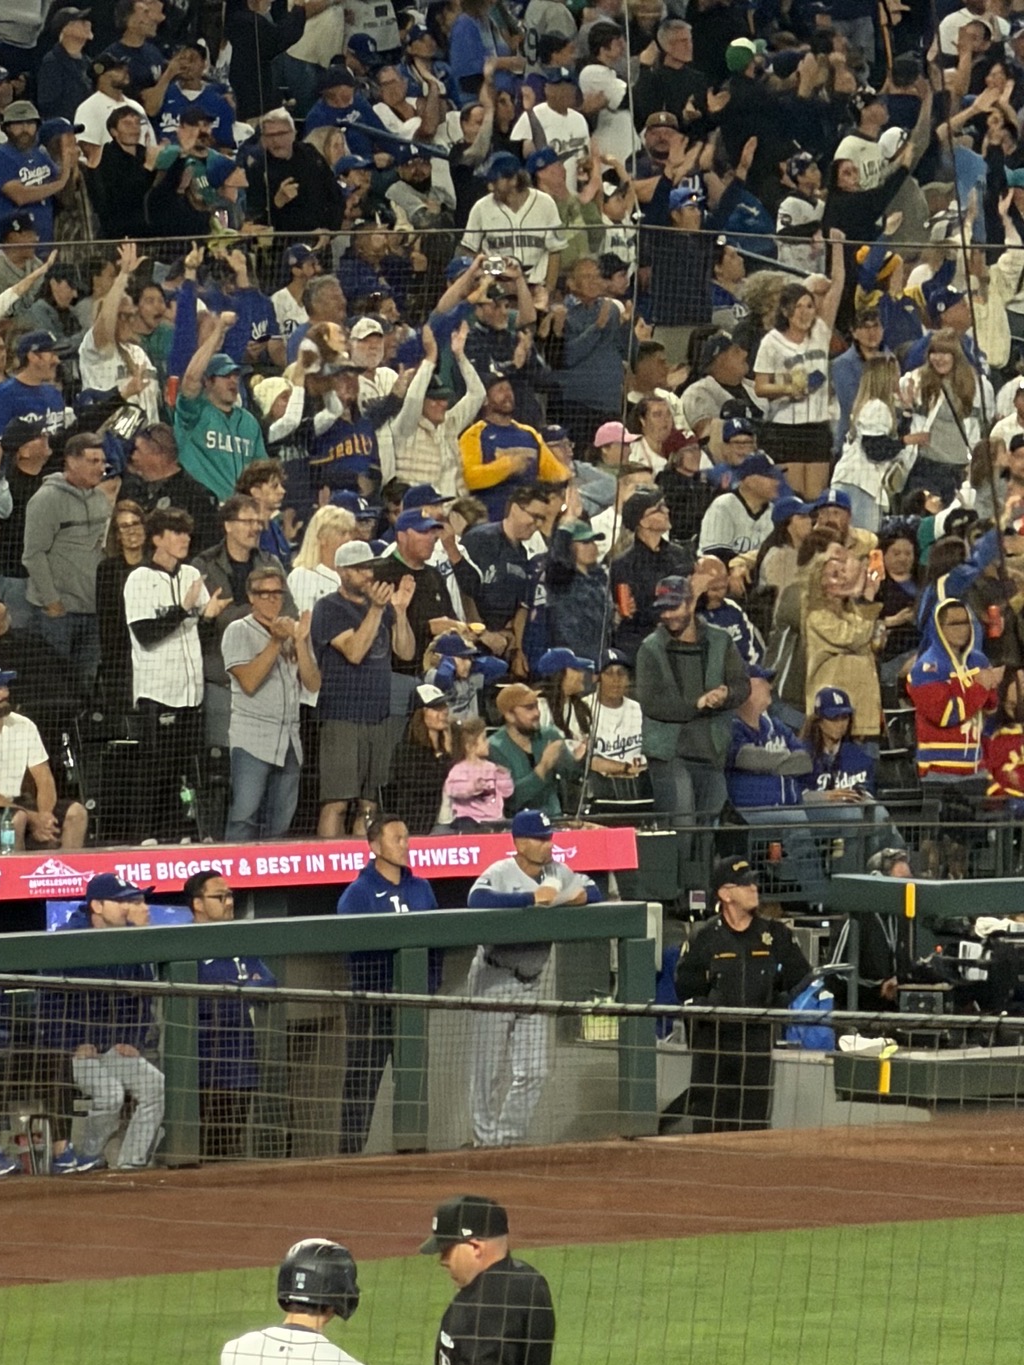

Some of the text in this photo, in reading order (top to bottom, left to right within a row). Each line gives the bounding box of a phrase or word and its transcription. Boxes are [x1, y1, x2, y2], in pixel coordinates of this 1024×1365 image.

[114, 862, 152, 884] THE
[238, 858, 252, 876] &
[255, 855, 302, 875] BEST
[305, 854, 325, 872] IN
[328, 851, 365, 871] THE
